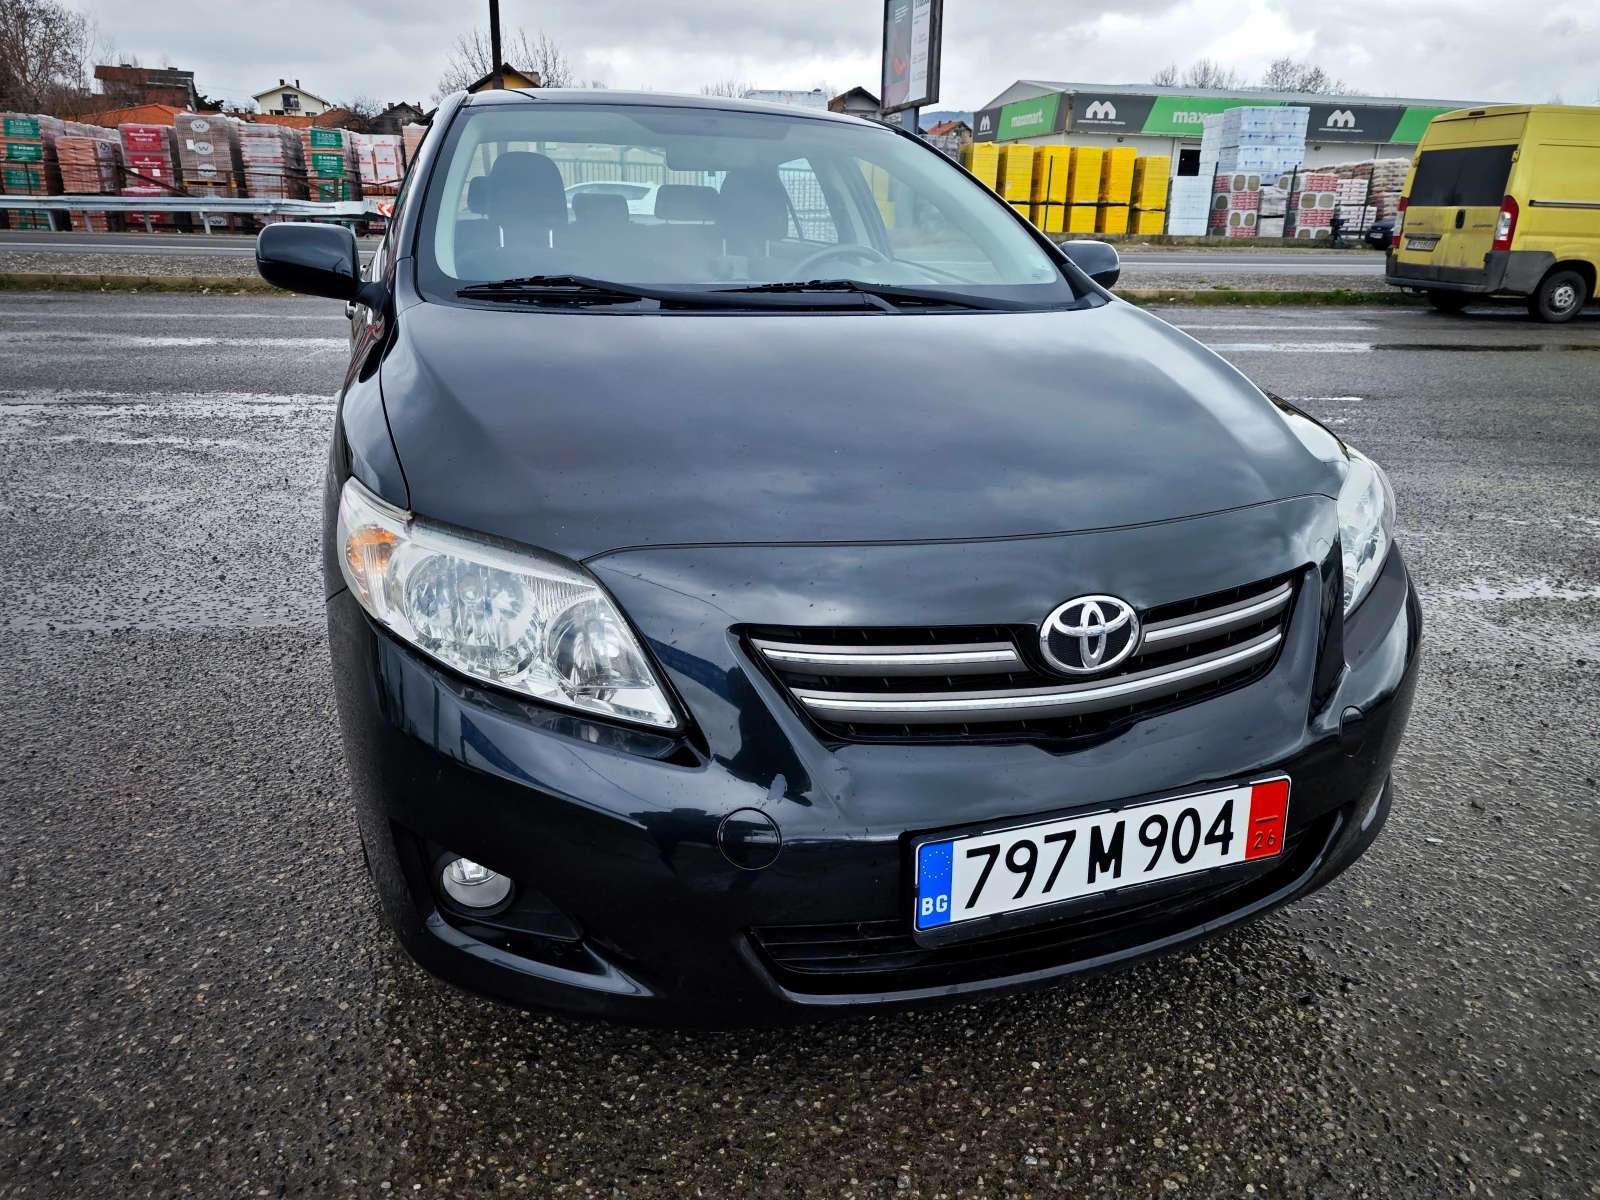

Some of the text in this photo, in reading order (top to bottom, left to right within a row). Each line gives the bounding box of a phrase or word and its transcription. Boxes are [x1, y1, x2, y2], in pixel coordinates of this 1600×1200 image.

[1253, 830, 1276, 850] 26
[965, 799, 1233, 909] 797 M 904
[921, 893, 948, 916] BG
